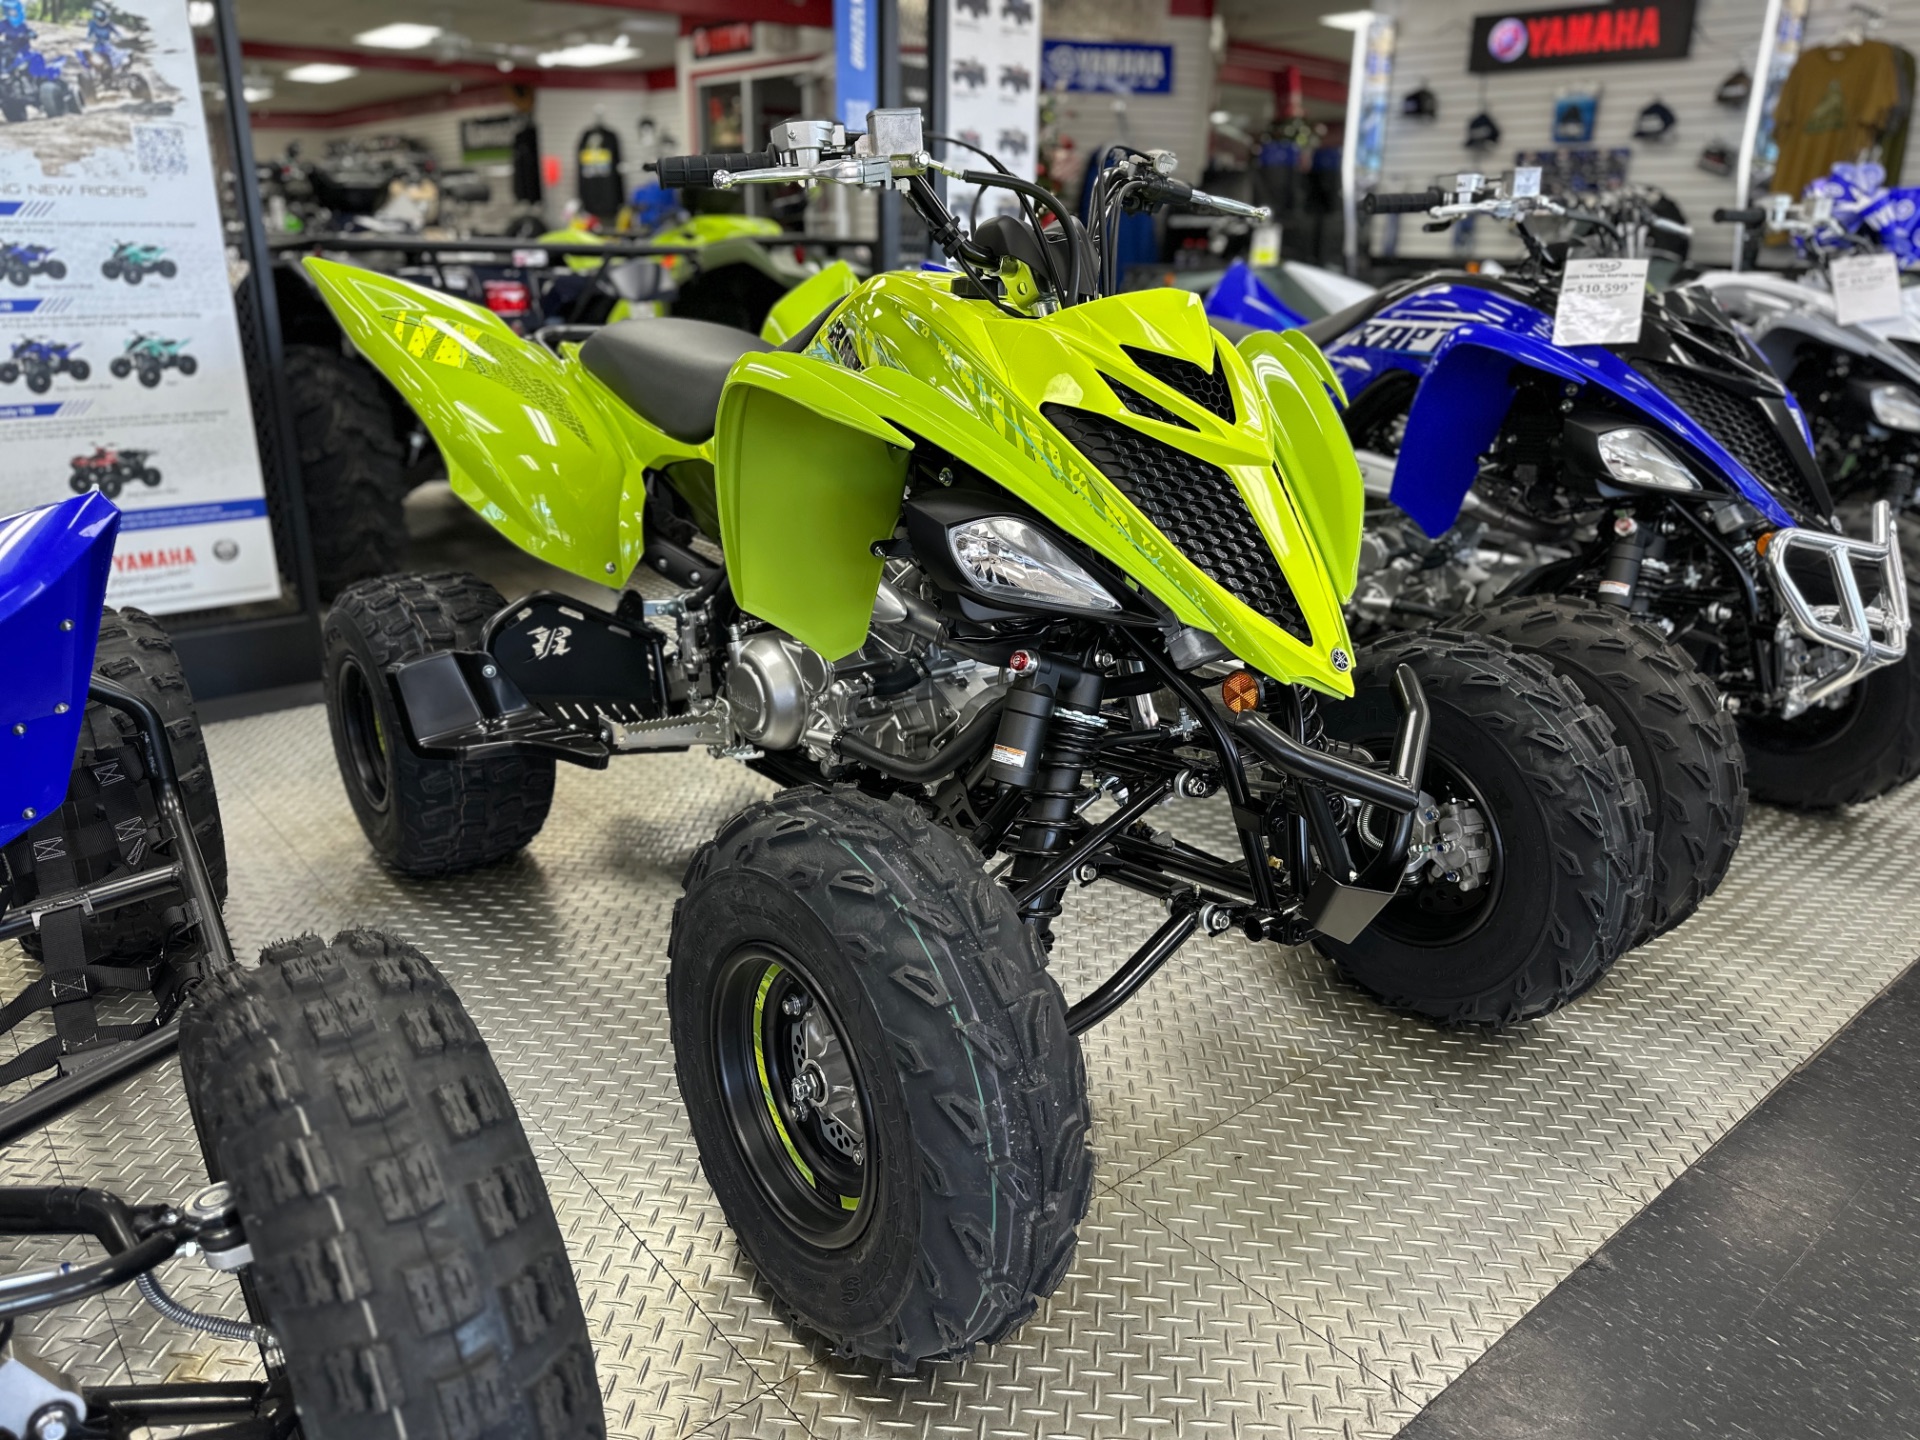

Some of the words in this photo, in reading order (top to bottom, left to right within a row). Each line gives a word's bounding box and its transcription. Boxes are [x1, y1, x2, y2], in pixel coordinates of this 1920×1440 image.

[1527, 7, 1659, 58] YAMAHA
[27, 184, 73, 197] NEW
[80, 184, 148, 198] RIDERS
[113, 547, 196, 573] YAMAHA
